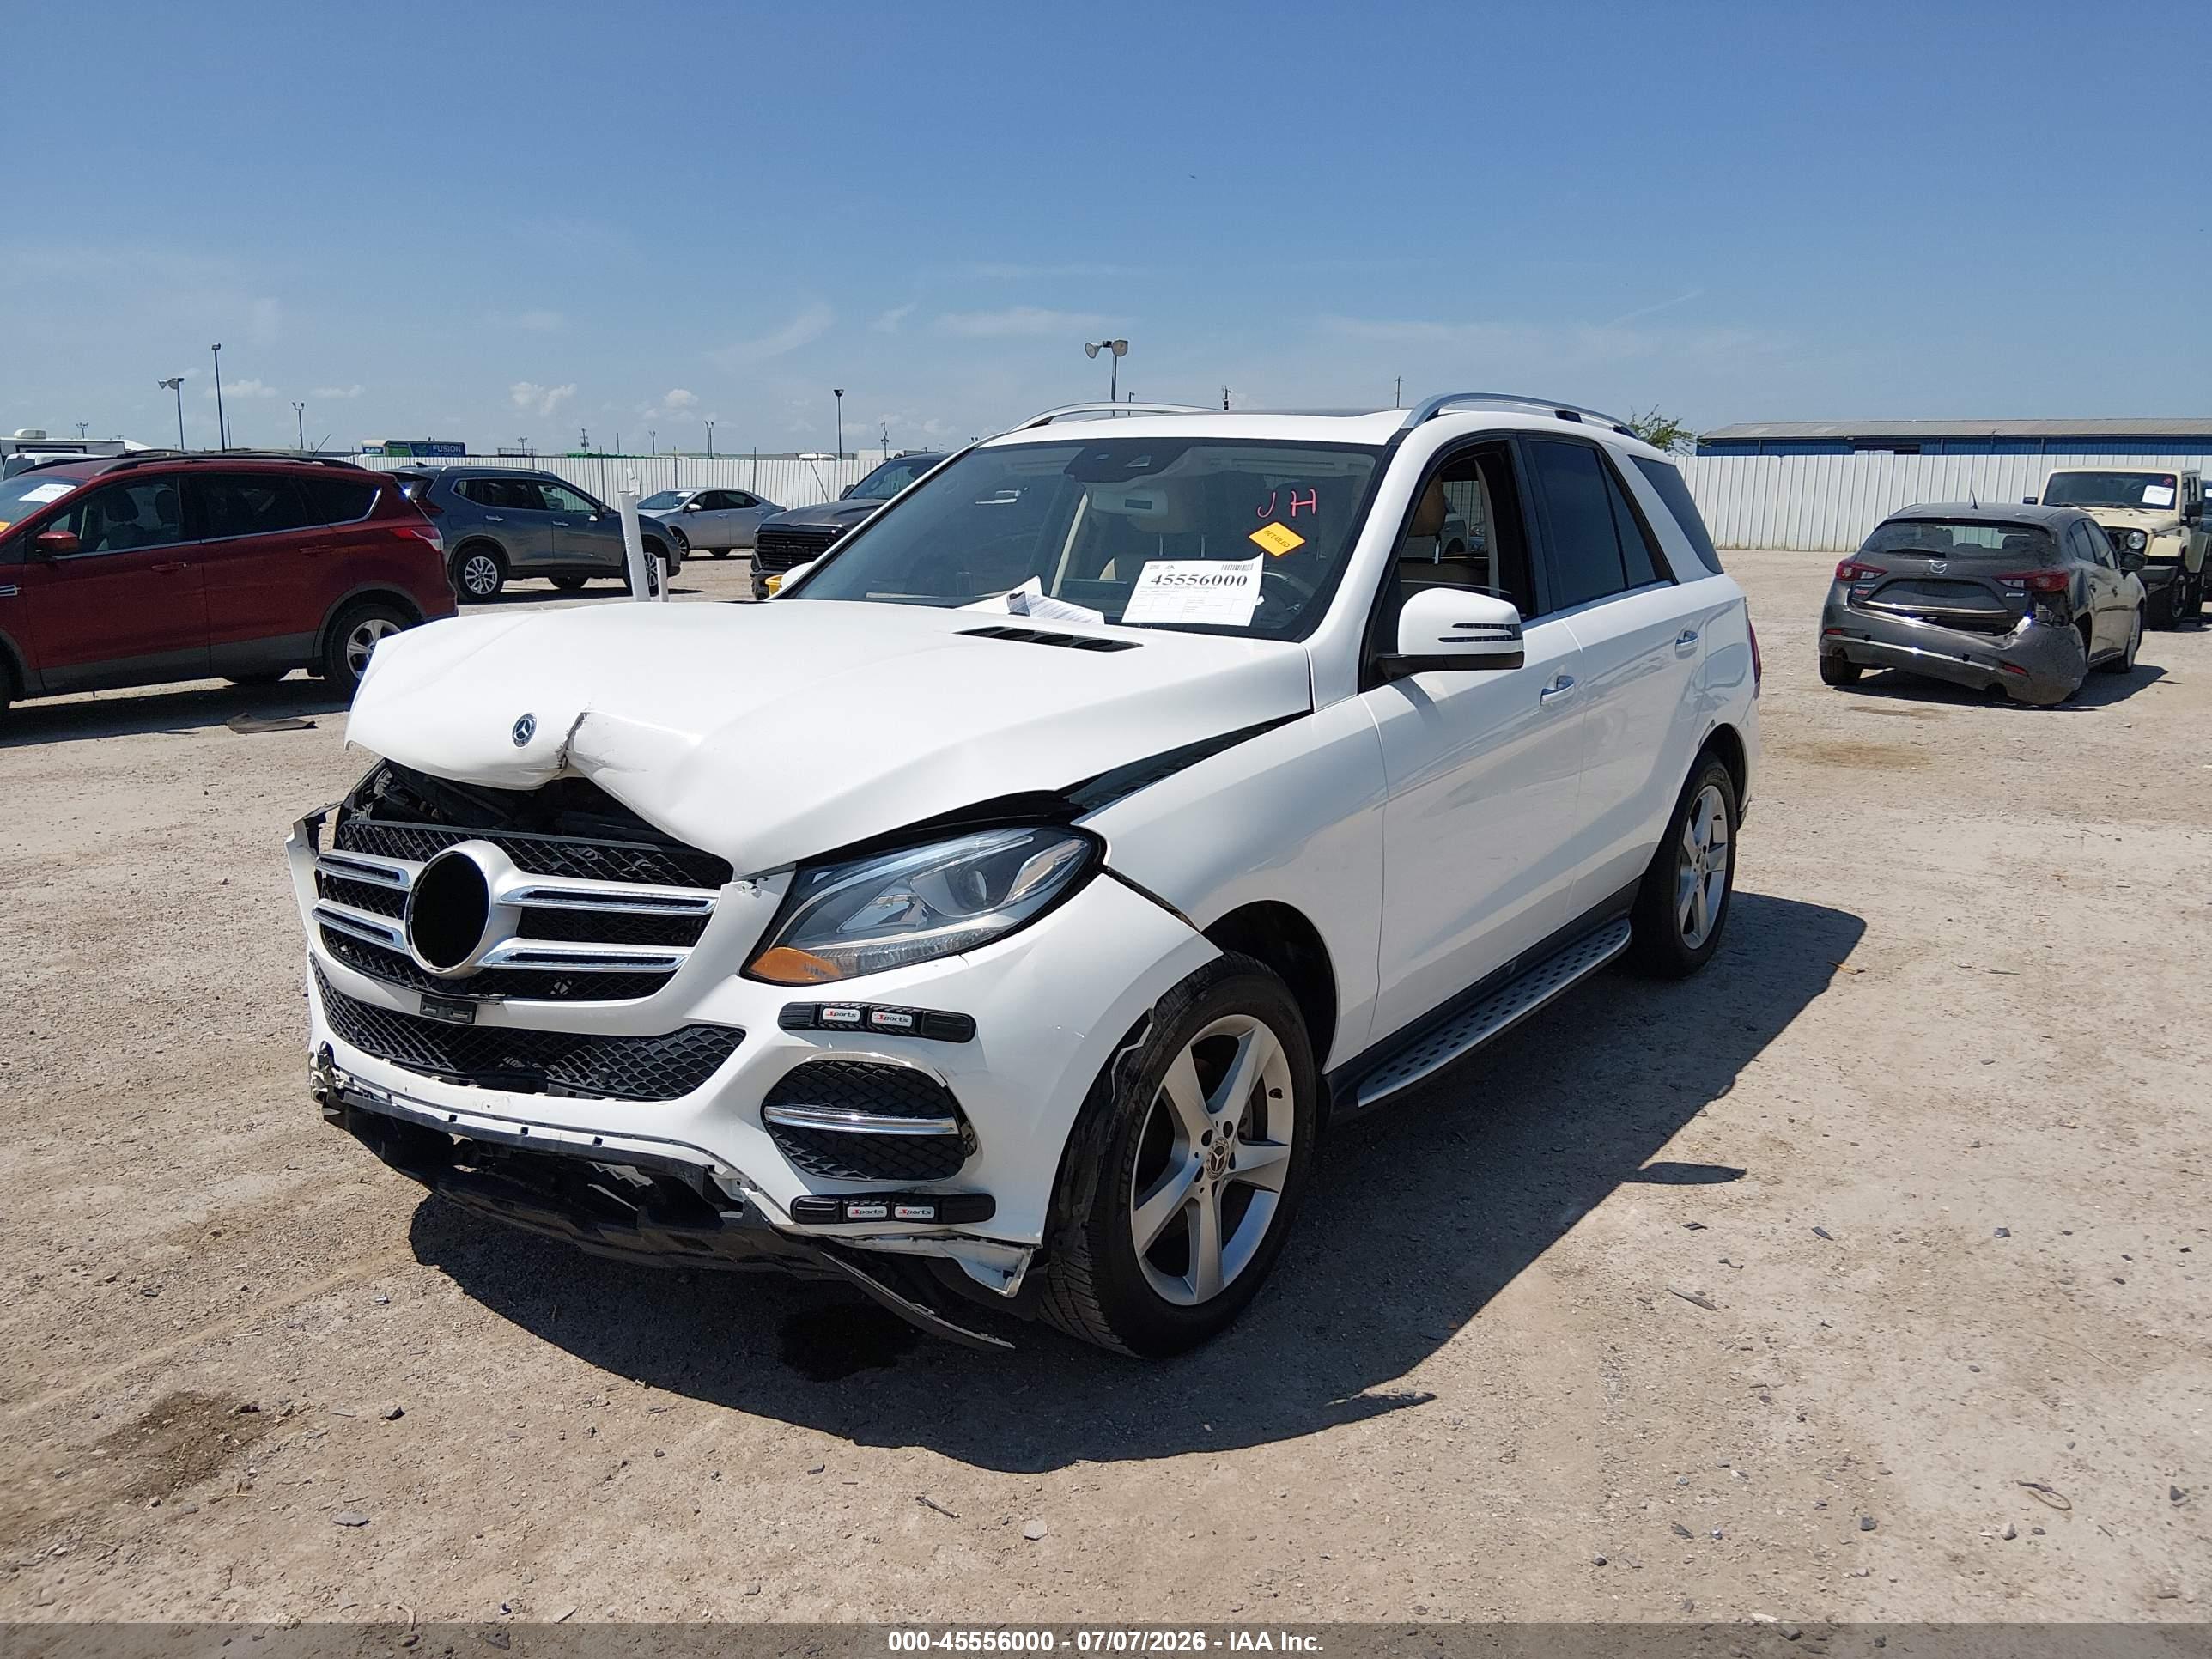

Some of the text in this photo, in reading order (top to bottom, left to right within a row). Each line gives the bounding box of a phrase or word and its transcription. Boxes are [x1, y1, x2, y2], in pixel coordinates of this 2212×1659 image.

[1256, 489, 1316, 518] J H
[1151, 574, 1248, 586] 45556000
